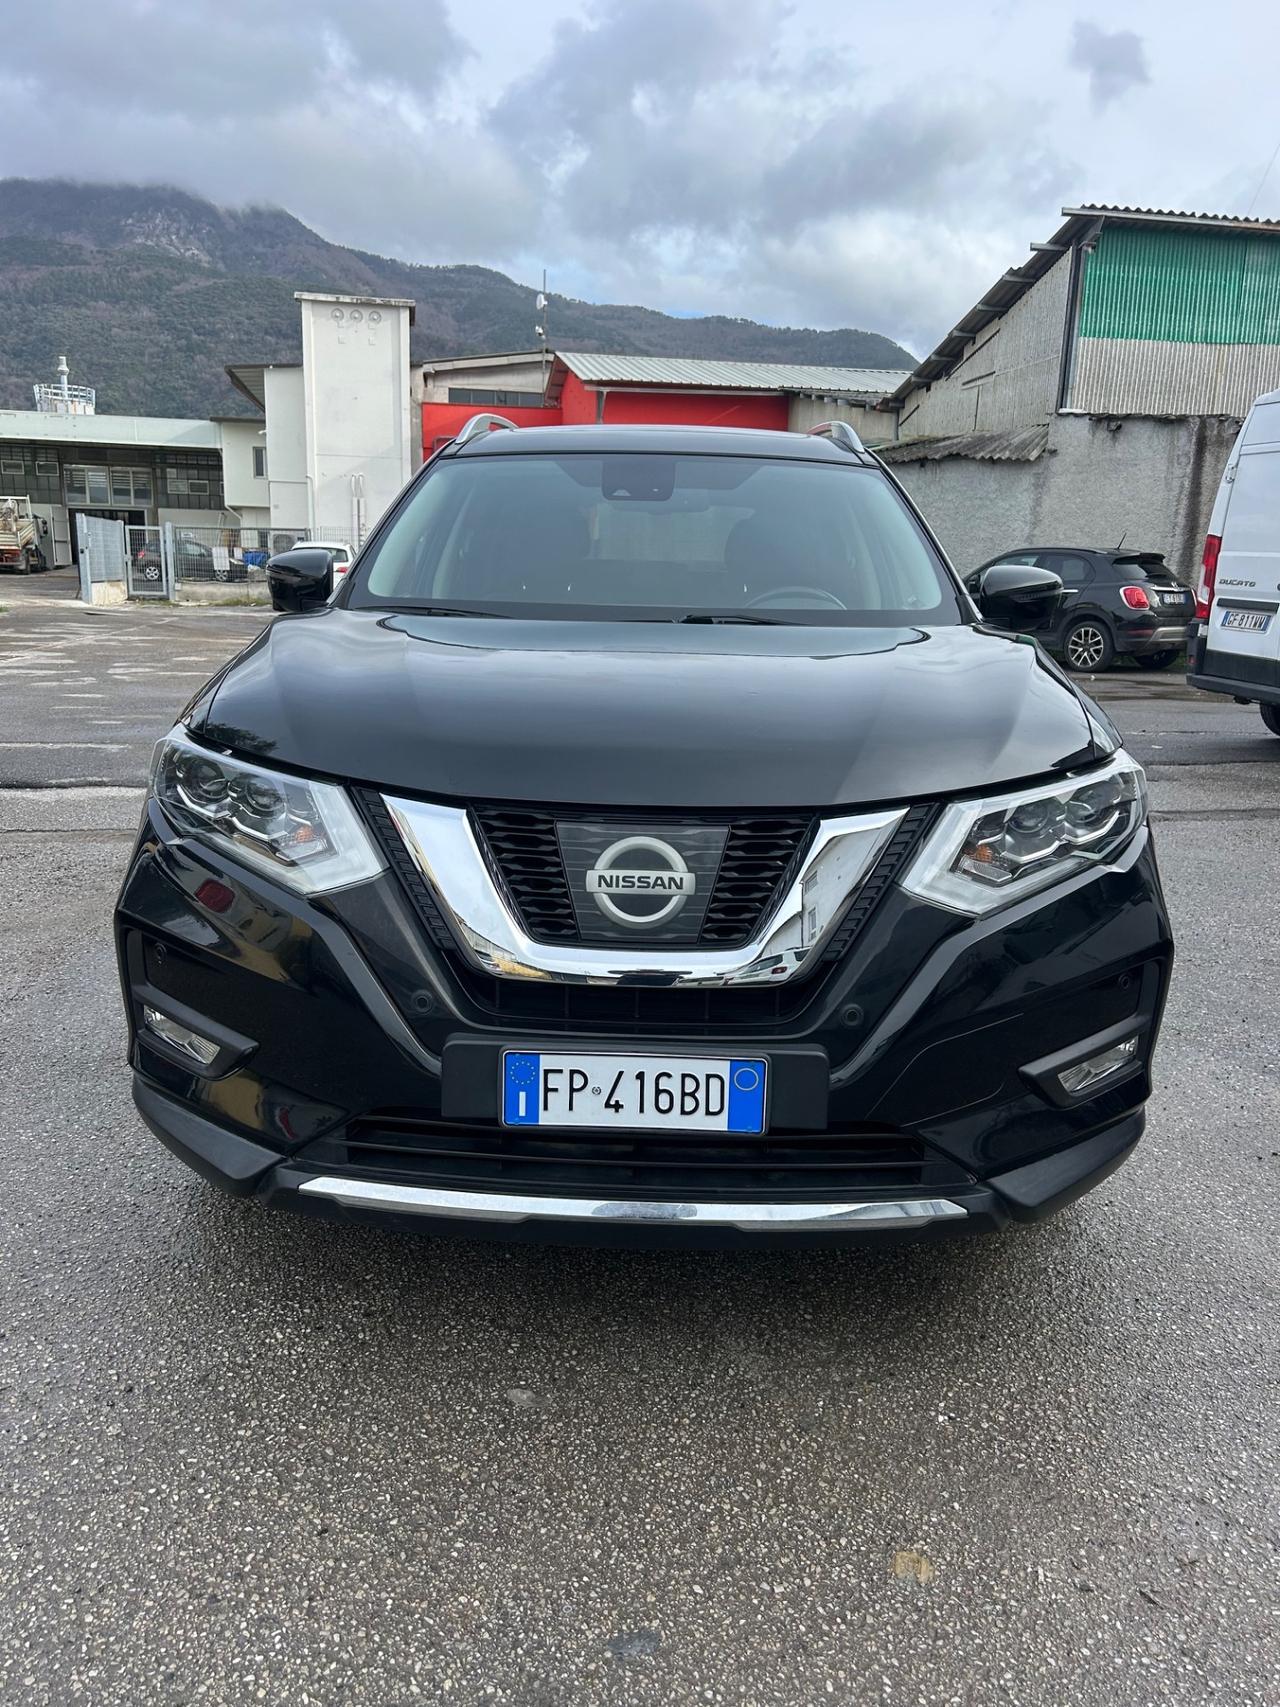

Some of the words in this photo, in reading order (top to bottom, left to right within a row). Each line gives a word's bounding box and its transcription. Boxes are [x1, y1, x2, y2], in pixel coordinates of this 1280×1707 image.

[1219, 579, 1256, 588] DUCATO
[598, 875, 684, 890] NISSAN
[543, 1068, 588, 1112] FP
[604, 1070, 725, 1116] 416BD
